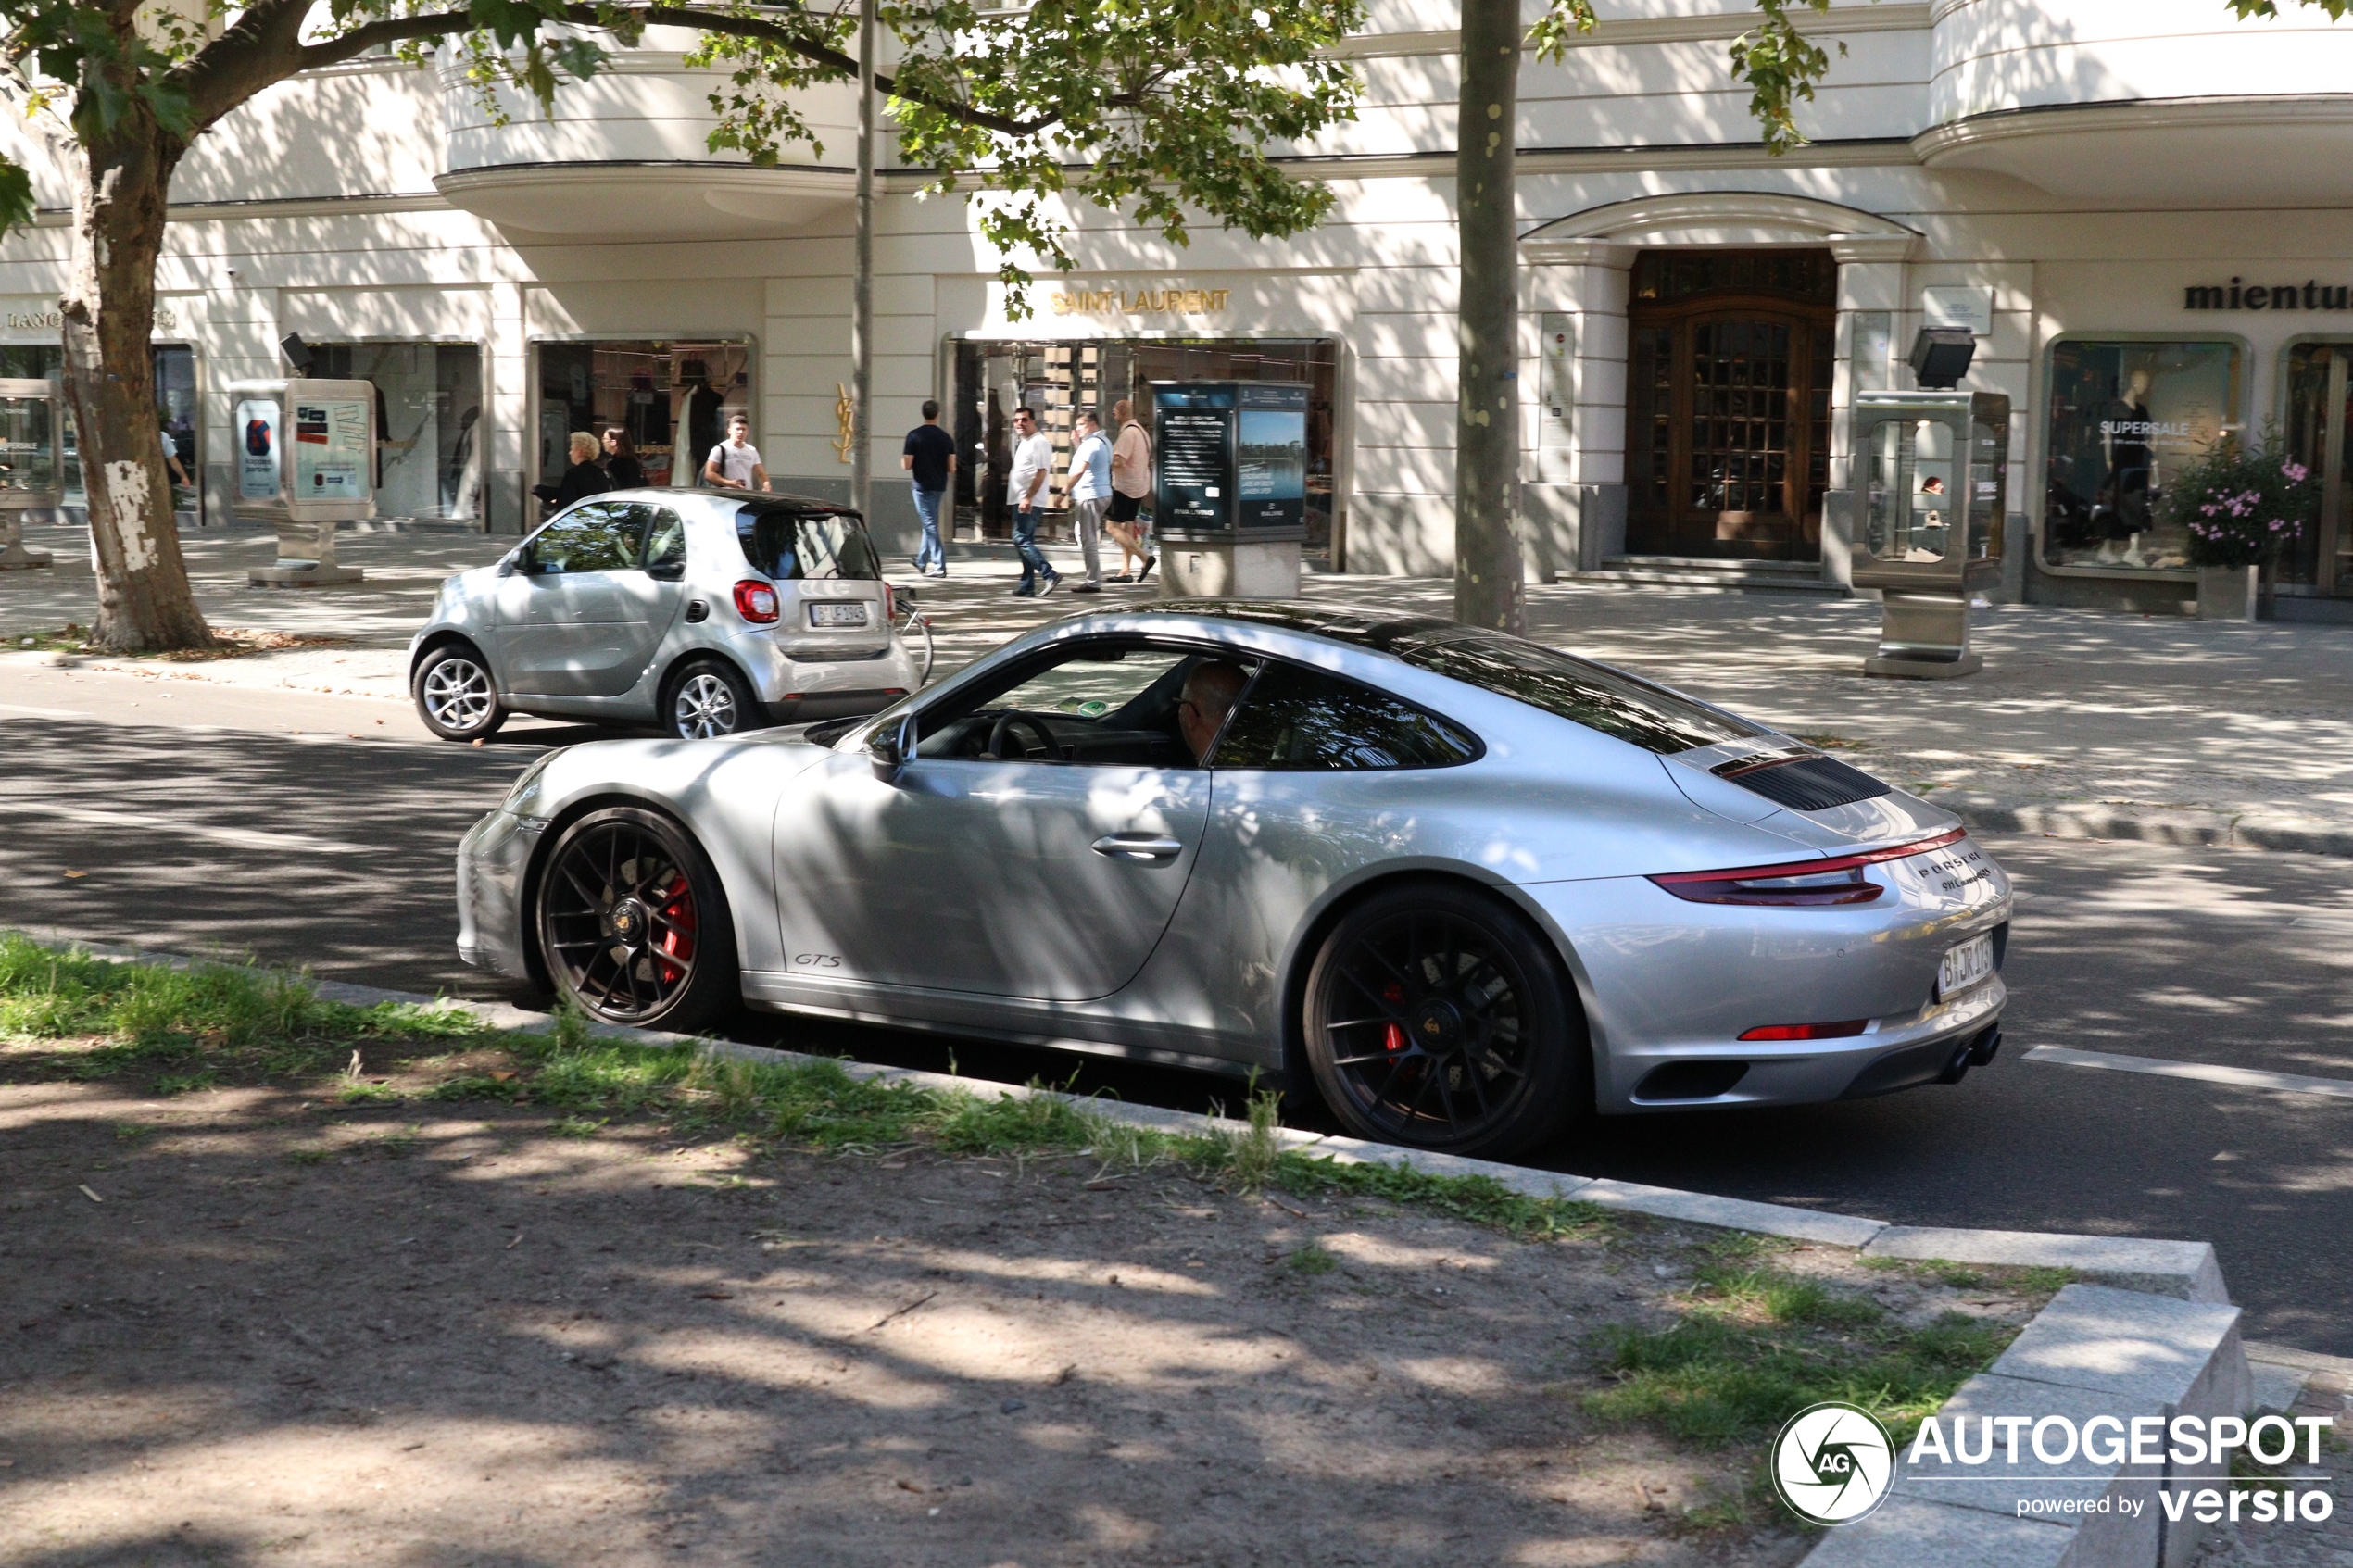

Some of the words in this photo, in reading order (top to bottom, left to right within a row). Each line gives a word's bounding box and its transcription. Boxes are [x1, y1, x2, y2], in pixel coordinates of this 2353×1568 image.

[1050, 289, 1114, 313] SAINT
[1120, 289, 1230, 313] LAURENT
[2183, 276, 2353, 310] mientu
[2099, 420, 2190, 436] SUPERSALE
[1918, 851, 1982, 879] PORSCHE
[1942, 879, 1956, 892] 911
[795, 953, 842, 968] GTS
[1944, 953, 1953, 988] B
